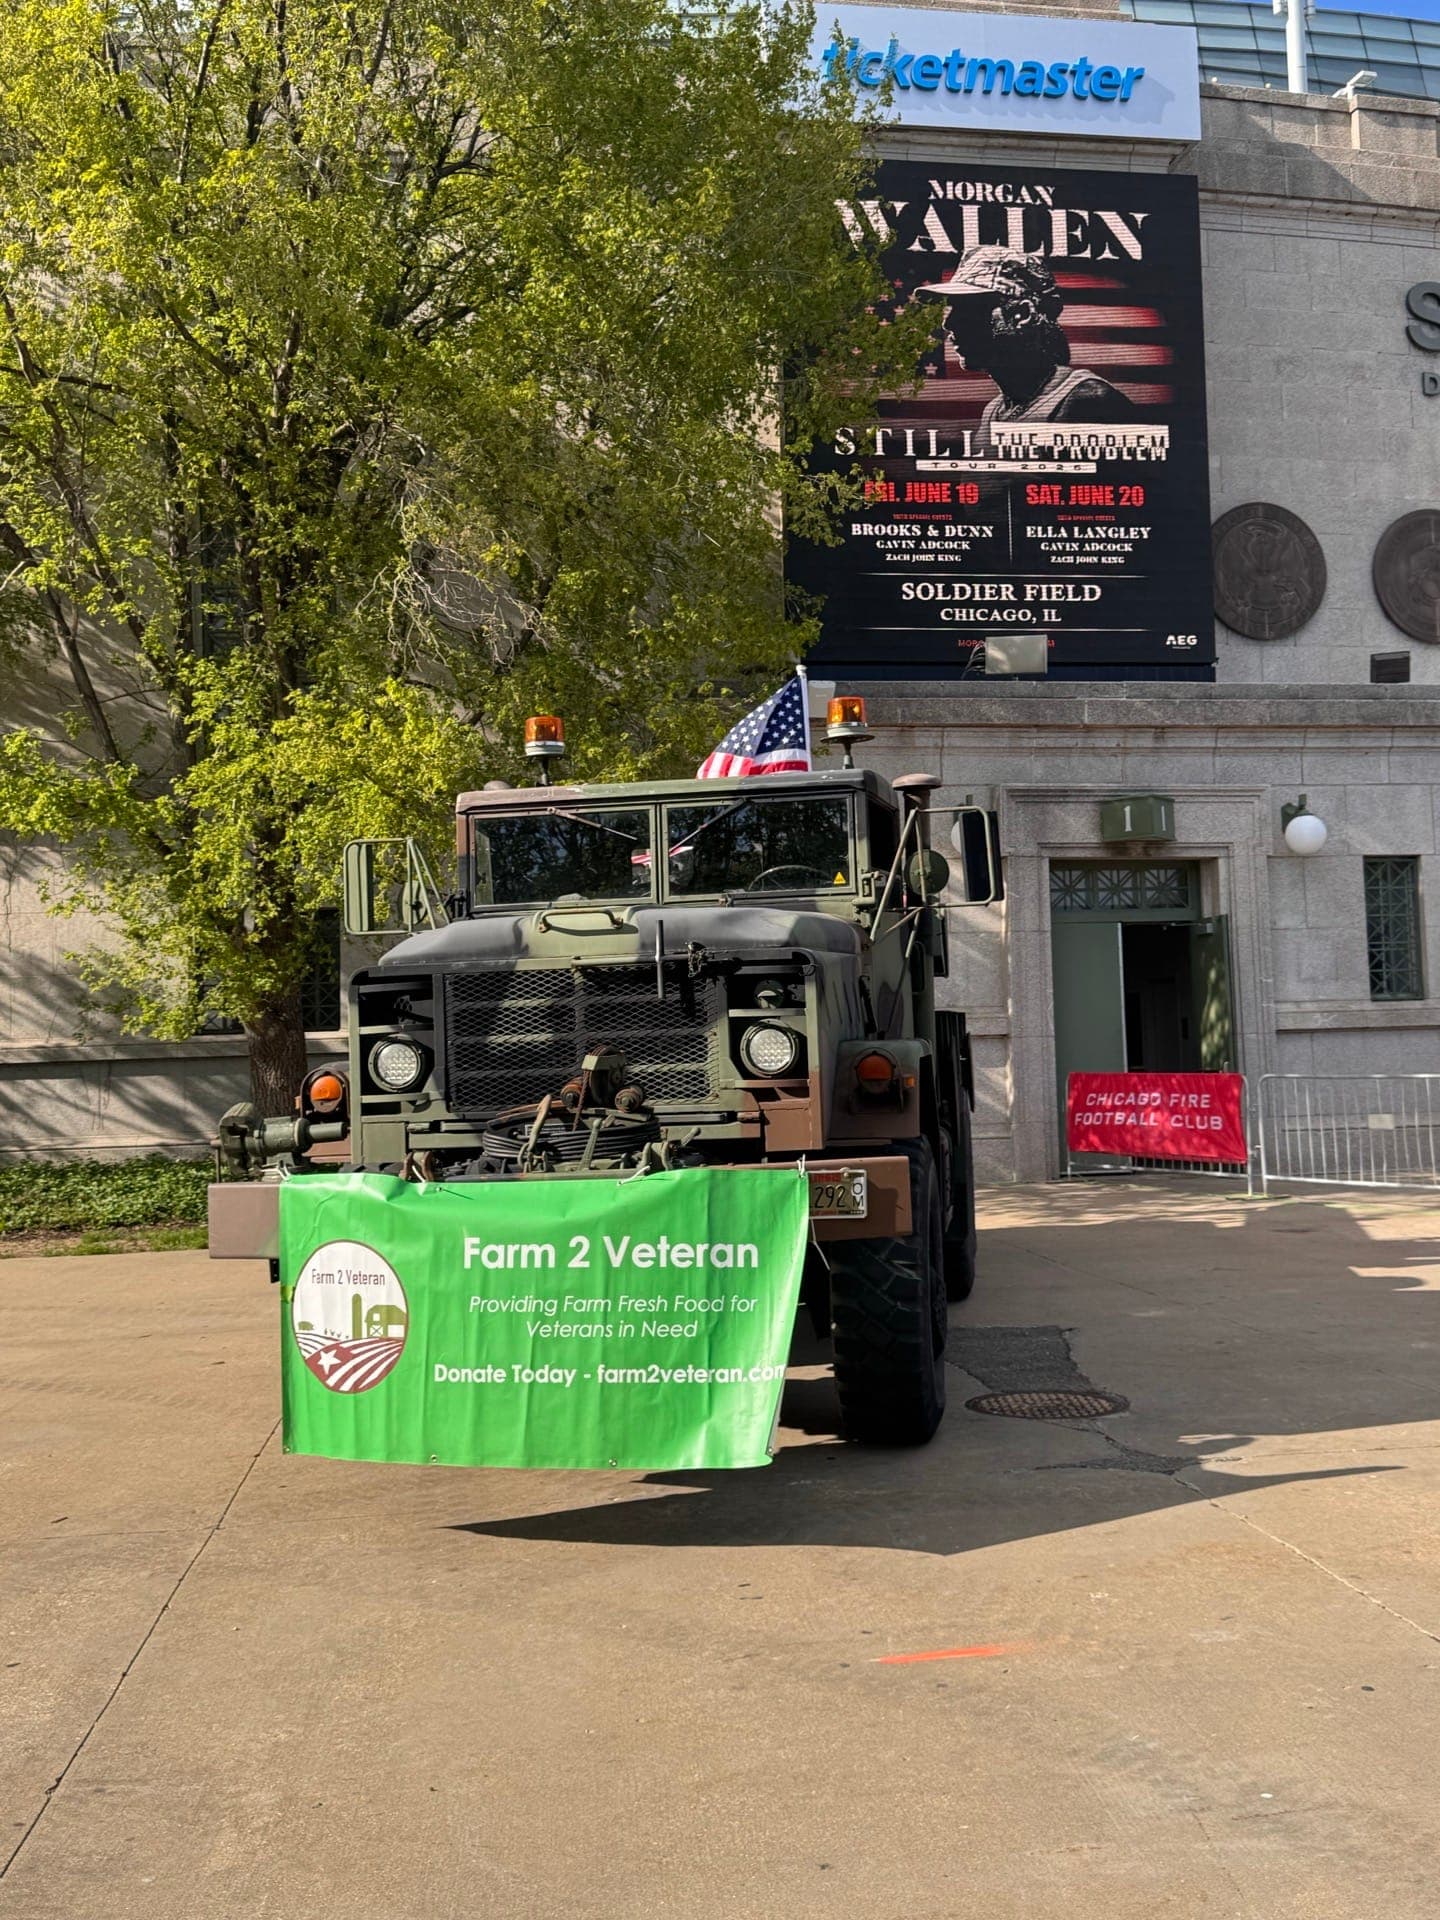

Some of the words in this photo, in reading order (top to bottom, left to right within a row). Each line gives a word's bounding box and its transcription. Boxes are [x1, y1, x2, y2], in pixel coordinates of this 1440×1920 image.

[822, 37, 1145, 101] ticketmaster
[928, 179, 1056, 206] MORGAN
[833, 199, 1149, 260] WALLEN
[834, 427, 985, 457] STILL
[995, 433, 1039, 459] THE
[1053, 434, 1167, 461] PROBLEM
[904, 481, 951, 503] JUNE
[955, 482, 979, 504] 19
[1026, 484, 1065, 506] SAT.
[1069, 484, 1116, 506] JUNE
[1119, 485, 1145, 507] 20
[851, 523, 922, 536] BROOKS
[927, 525, 939, 537] &
[944, 525, 994, 537] DUNN
[1026, 526, 1068, 538] ELLA
[1073, 527, 1151, 539] LANGLEY
[876, 540, 916, 549] GAVIN
[919, 541, 971, 550] ADCOCK
[1040, 542, 1079, 551] GAVIN
[1083, 543, 1133, 552] ADCOCK
[912, 554, 936, 562] JOHN
[938, 554, 962, 562] KING
[1076, 556, 1098, 564] JOHN
[902, 582, 1018, 600] SOLDIER
[1023, 584, 1101, 601] FIELD
[940, 608, 1037, 623] CHICAGO,
[1042, 608, 1062, 622] IL
[1166, 635, 1198, 645] AEG
[1086, 1093, 1161, 1106] CHICAGO
[1169, 1094, 1211, 1108] FIRE
[1074, 1112, 1159, 1126] FOOTBALL
[1170, 1114, 1223, 1130] CLUB
[810, 1185, 846, 1209] 292
[464, 1237, 556, 1269] Farm
[567, 1236, 590, 1268] 2
[603, 1236, 759, 1268] Veteran
[312, 1269, 335, 1284] Farm
[338, 1270, 344, 1285] 2
[346, 1270, 386, 1285] Veteran
[469, 1295, 557, 1316] Providing
[563, 1296, 611, 1312] Farm
[617, 1295, 669, 1312] Fresh
[674, 1295, 724, 1312] Food
[730, 1295, 757, 1312] for
[526, 1320, 613, 1338] Veterans
[618, 1320, 635, 1338] in
[641, 1320, 698, 1338] Need
[434, 1364, 506, 1383] Donate
[511, 1364, 577, 1387] Today
